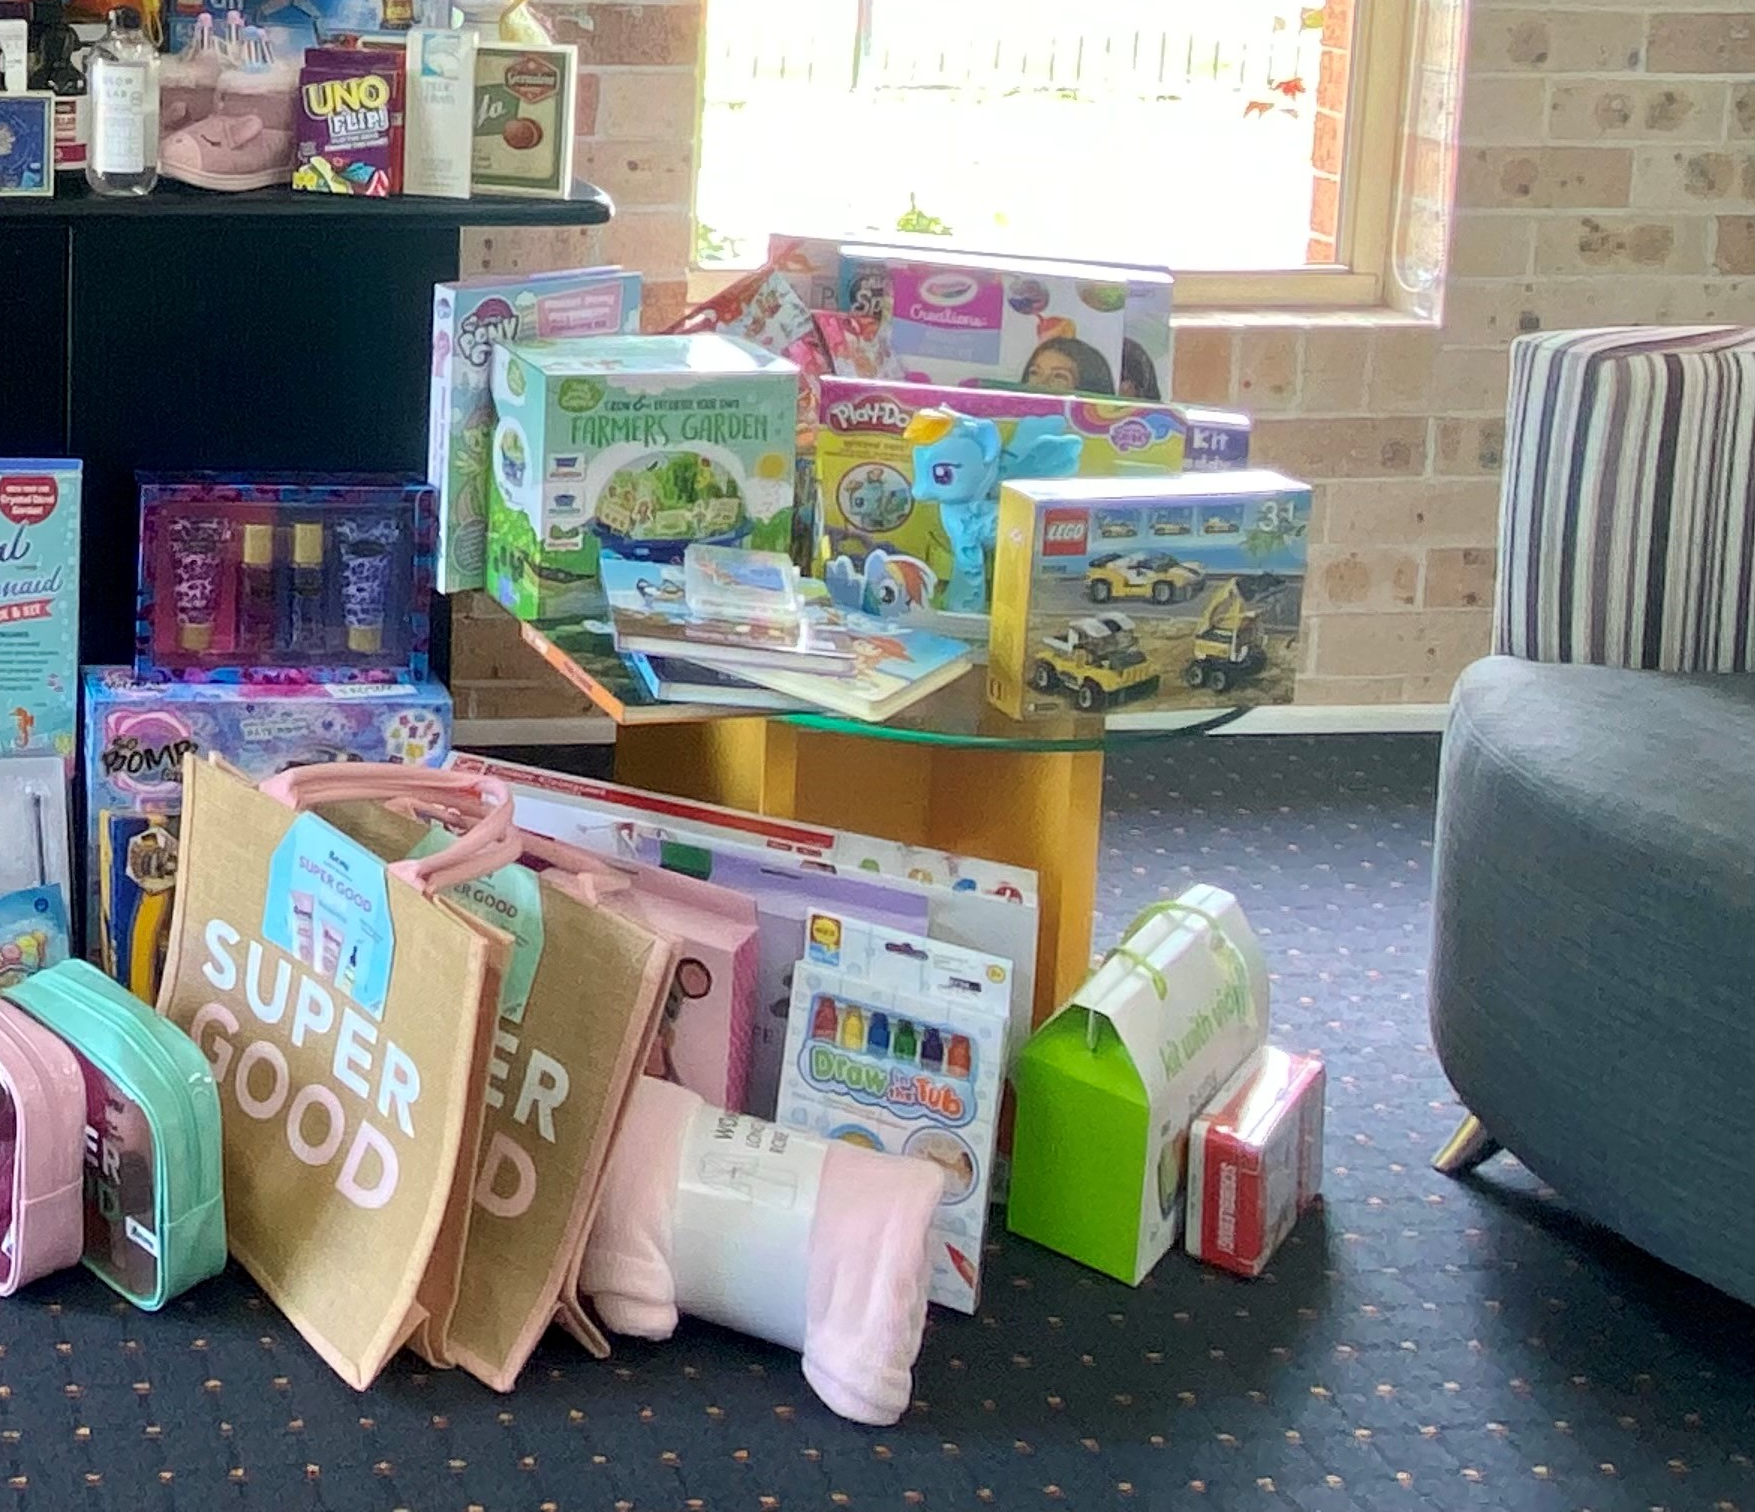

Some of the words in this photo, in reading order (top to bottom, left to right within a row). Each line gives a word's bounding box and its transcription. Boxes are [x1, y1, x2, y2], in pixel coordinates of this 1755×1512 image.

[307, 74, 390, 116] UNO
[332, 108, 387, 135] FLIP!
[571, 414, 670, 448] FARMERS
[681, 412, 769, 443] GARDEN
[829, 402, 910, 429] Play-Do
[1048, 522, 1085, 539] LEGO
[298, 855, 335, 889] SUPER
[335, 881, 373, 913] GOOD
[473, 889, 518, 919] GOOD
[202, 920, 422, 1138] SUPER
[812, 1047, 888, 1096] Draw
[914, 1076, 963, 1119] Tub
[190, 1002, 400, 1209] GOOD
